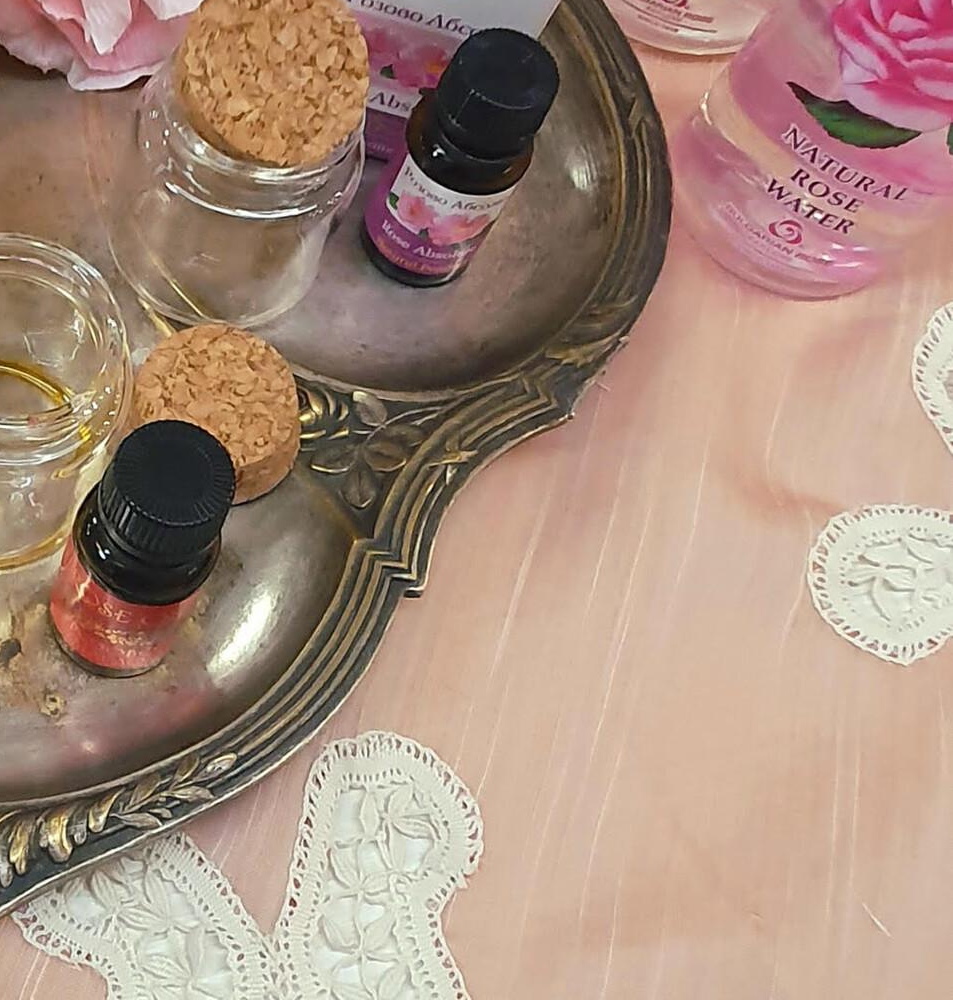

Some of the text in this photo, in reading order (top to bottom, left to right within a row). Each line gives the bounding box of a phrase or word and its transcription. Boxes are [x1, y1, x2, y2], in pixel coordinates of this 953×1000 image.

[783, 125, 909, 201] NATURAL
[790, 168, 864, 213] ROSE
[767, 178, 855, 234] WATER
